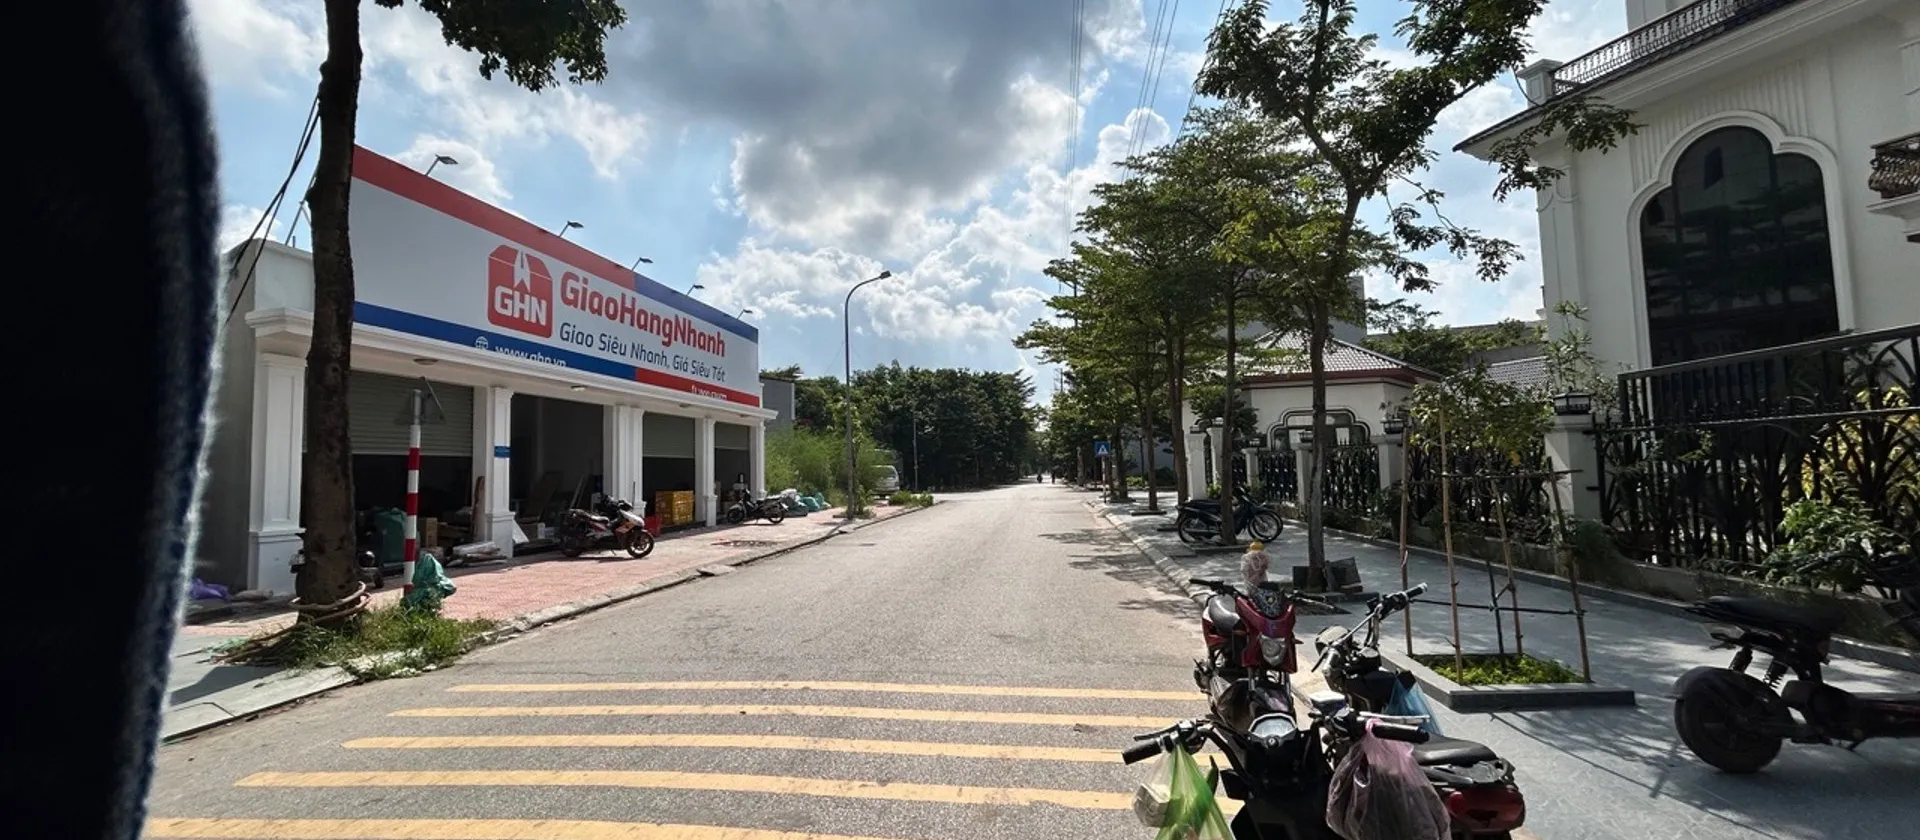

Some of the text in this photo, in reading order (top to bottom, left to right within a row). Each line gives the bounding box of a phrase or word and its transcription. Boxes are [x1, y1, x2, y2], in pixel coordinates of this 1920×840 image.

[494, 285, 547, 326] GHN
[561, 271, 725, 357] GiaoHangNhanh
[560, 322, 594, 347] Giao
[598, 333, 627, 356] Siêu
[630, 342, 670, 368] Nhanh,
[673, 355, 689, 372] Giá
[691, 360, 710, 378] Siêu
